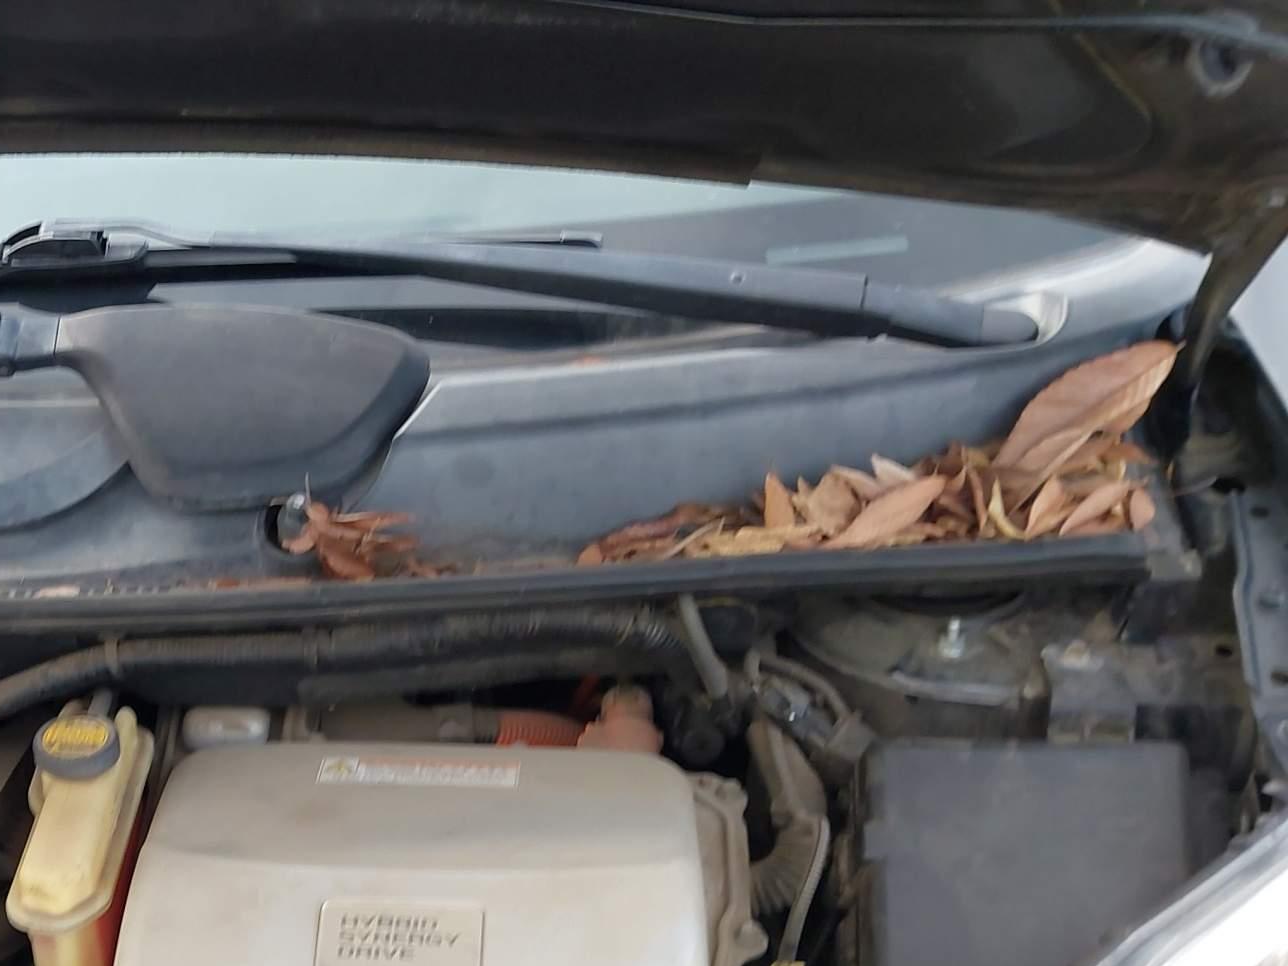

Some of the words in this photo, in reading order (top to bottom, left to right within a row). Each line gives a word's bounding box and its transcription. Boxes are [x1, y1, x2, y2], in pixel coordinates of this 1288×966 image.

[340, 914, 439, 930] HYBRID
[339, 930, 461, 947] SYNERGY
[337, 946, 416, 960] DRIVE
